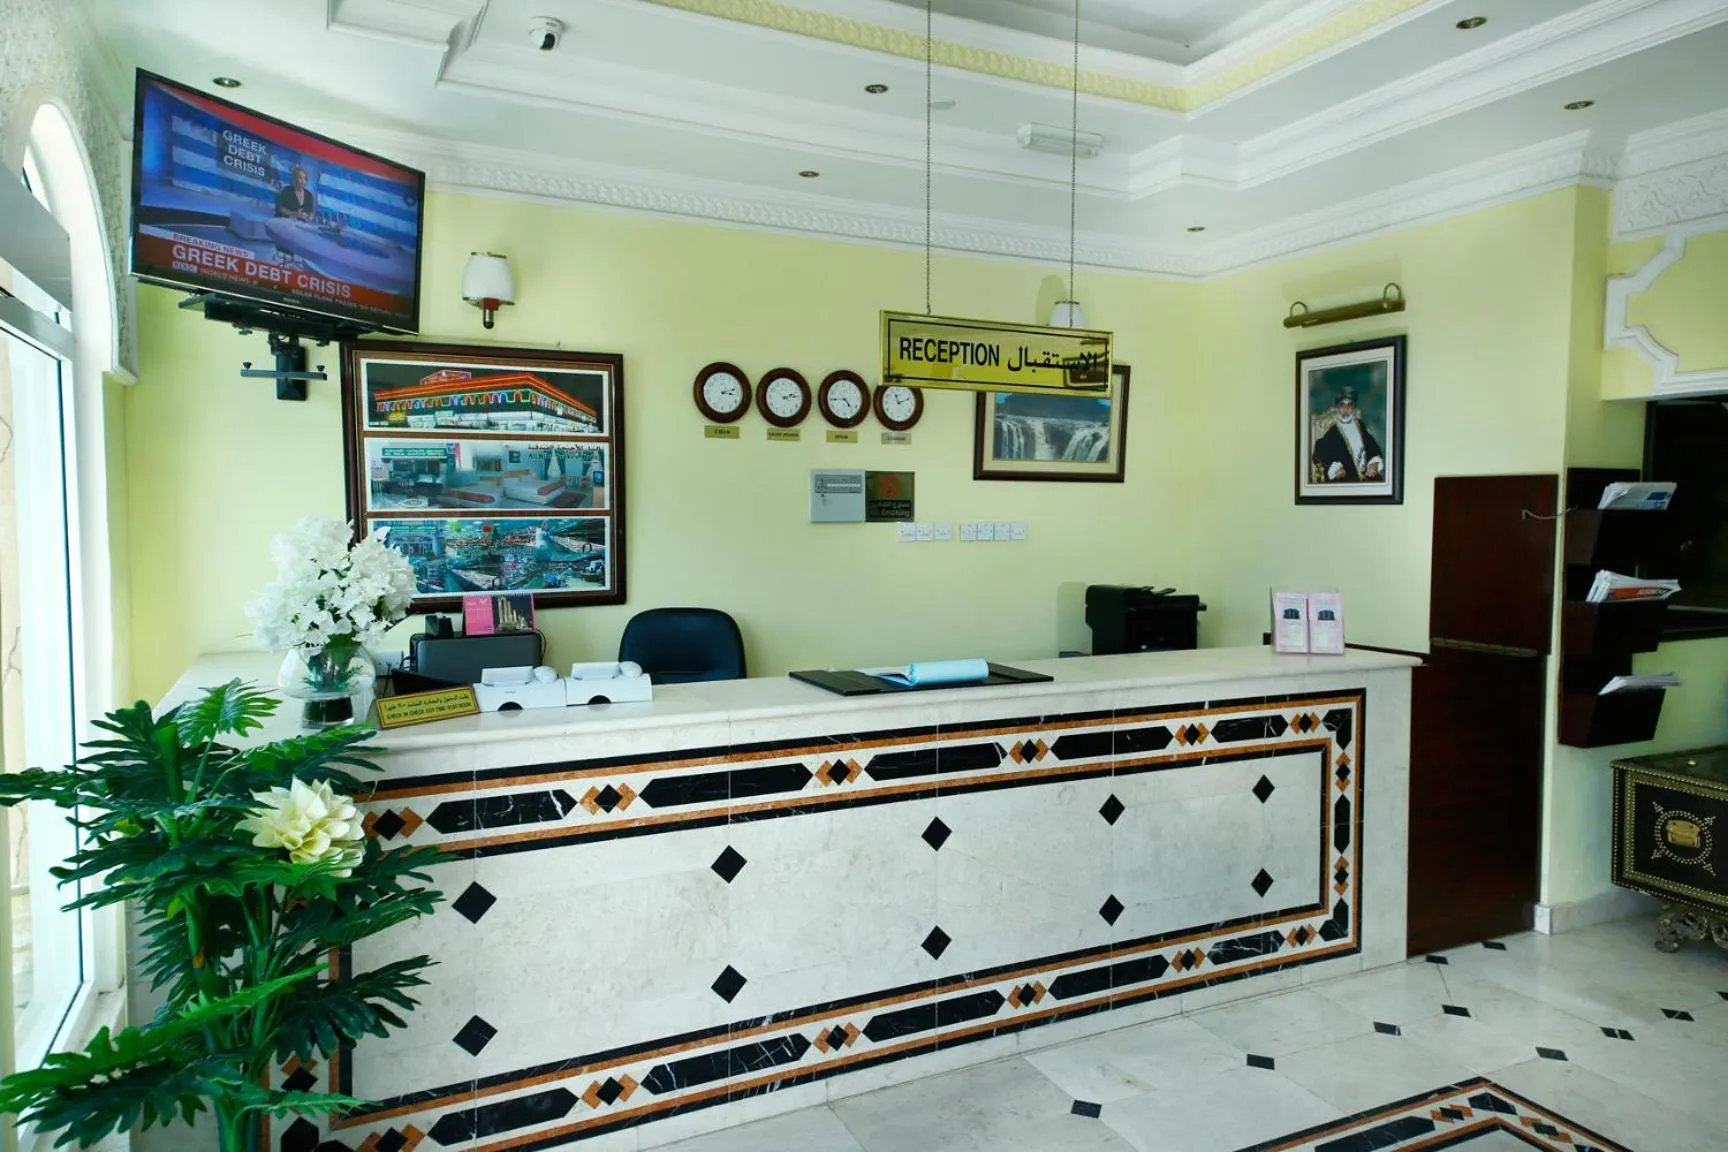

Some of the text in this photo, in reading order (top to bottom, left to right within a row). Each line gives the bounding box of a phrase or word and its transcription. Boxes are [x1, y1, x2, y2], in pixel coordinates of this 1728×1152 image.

[222, 130, 267, 155] GREEK
[228, 144, 263, 164] DEBT
[223, 155, 266, 177] CRISIS
[172, 244, 352, 298] GREEK DEBT CRISIS
[899, 337, 1000, 366] RECEPTION
